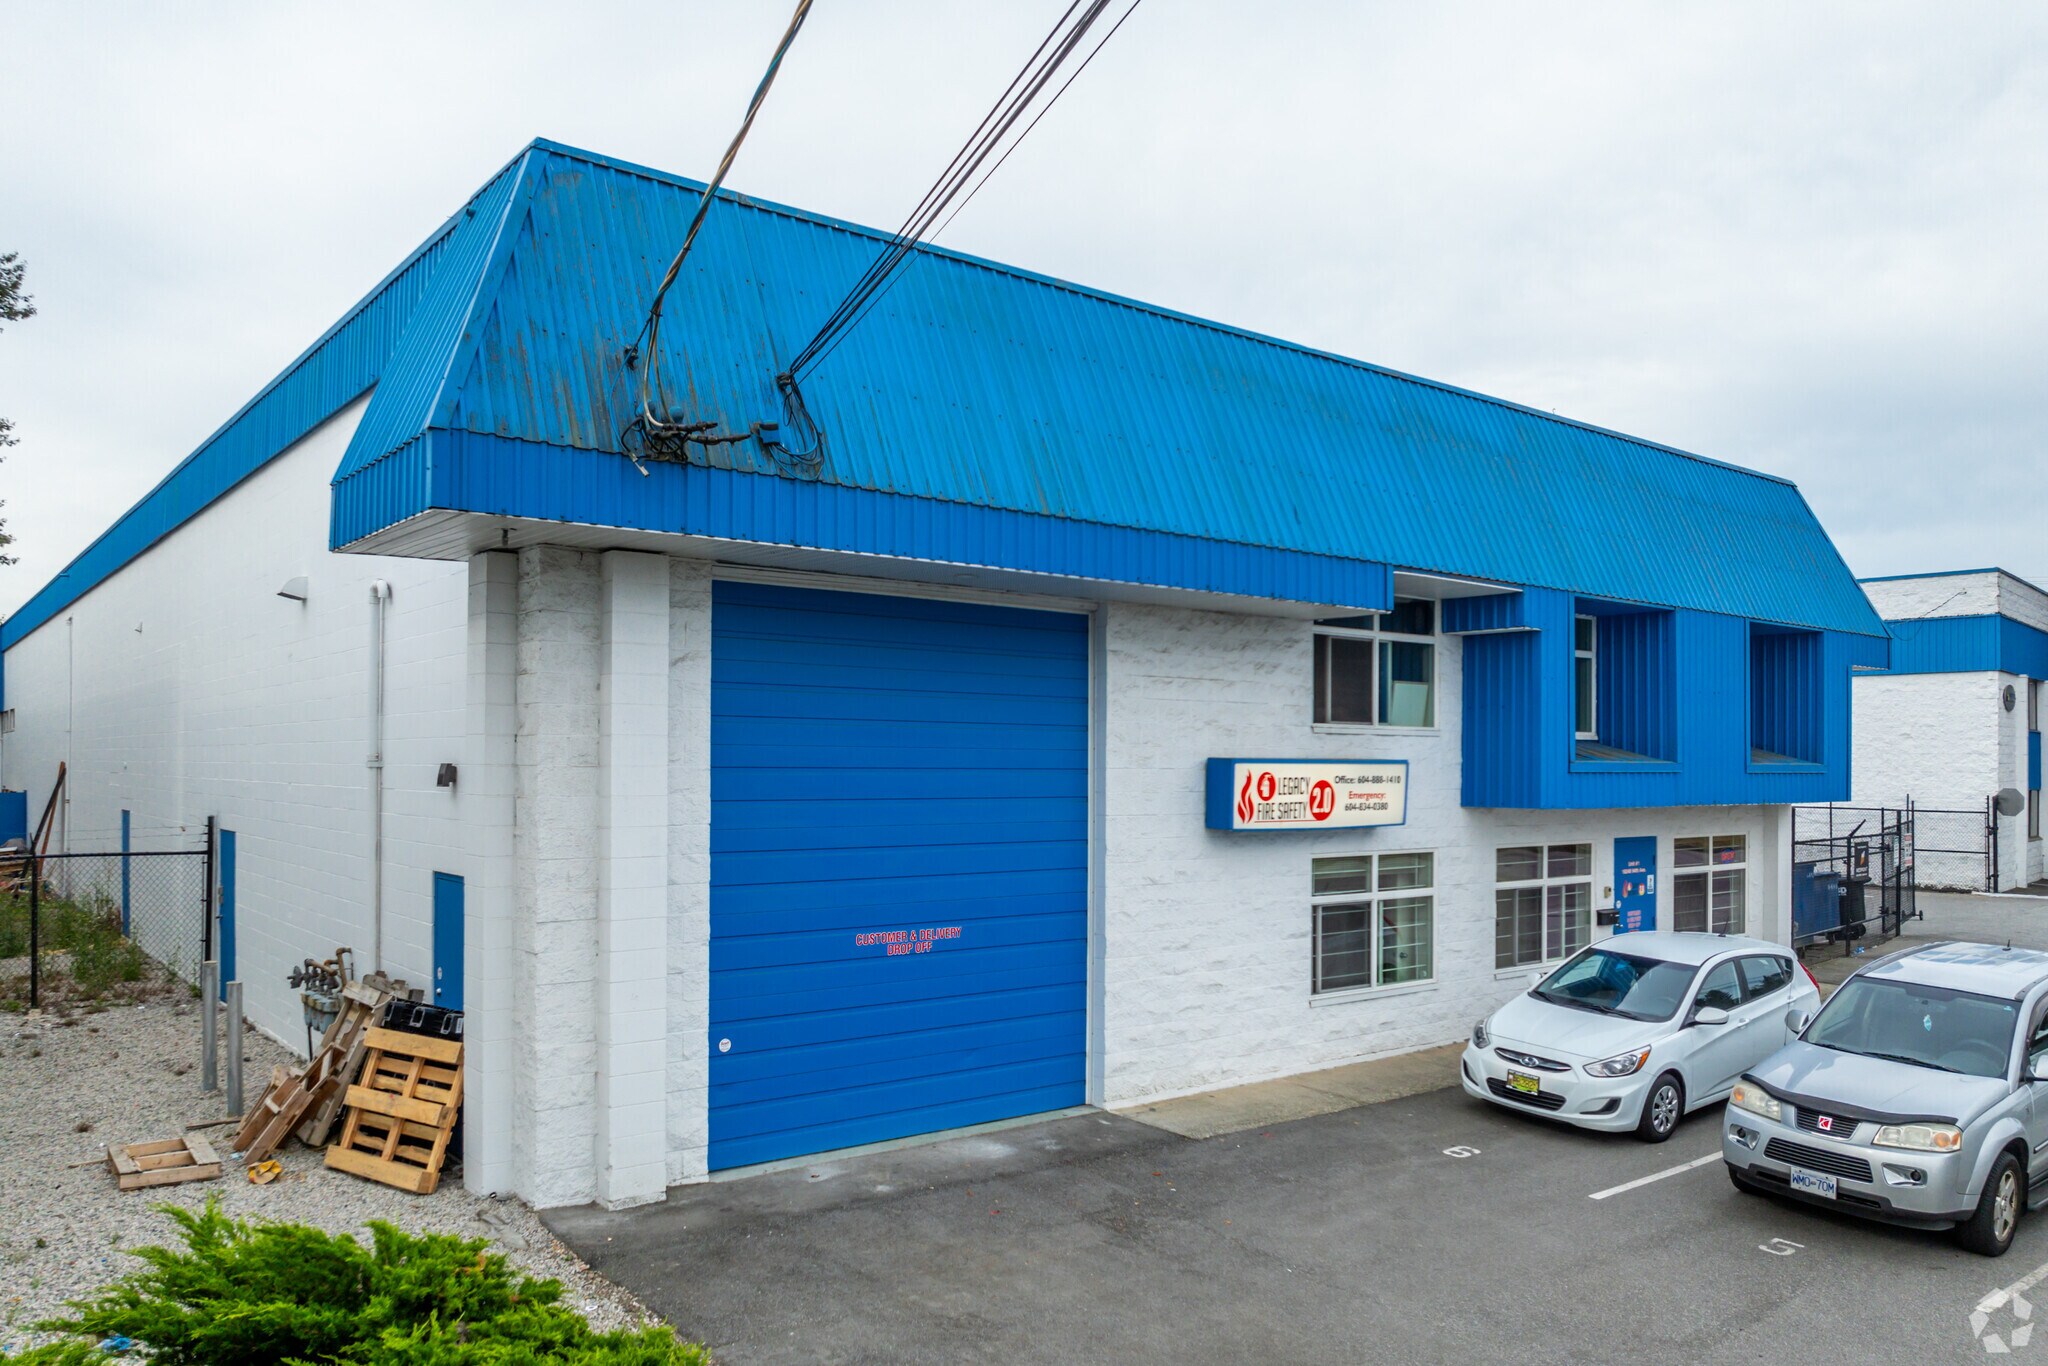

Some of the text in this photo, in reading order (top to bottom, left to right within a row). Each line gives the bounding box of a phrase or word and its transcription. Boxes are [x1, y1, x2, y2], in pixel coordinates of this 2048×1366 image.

[1278, 777, 1311, 795] LEGACY
[1335, 775, 1356, 784] Office:
[1348, 791, 1386, 801] Emergency:
[1257, 801, 1307, 820] FIRE SAFETY
[856, 926, 962, 946] CUSTOMER & DELIVERY
[887, 941, 932, 956] DROP OFF
[1442, 1145, 1481, 1158] 6
[1758, 1237, 1805, 1256] 5
